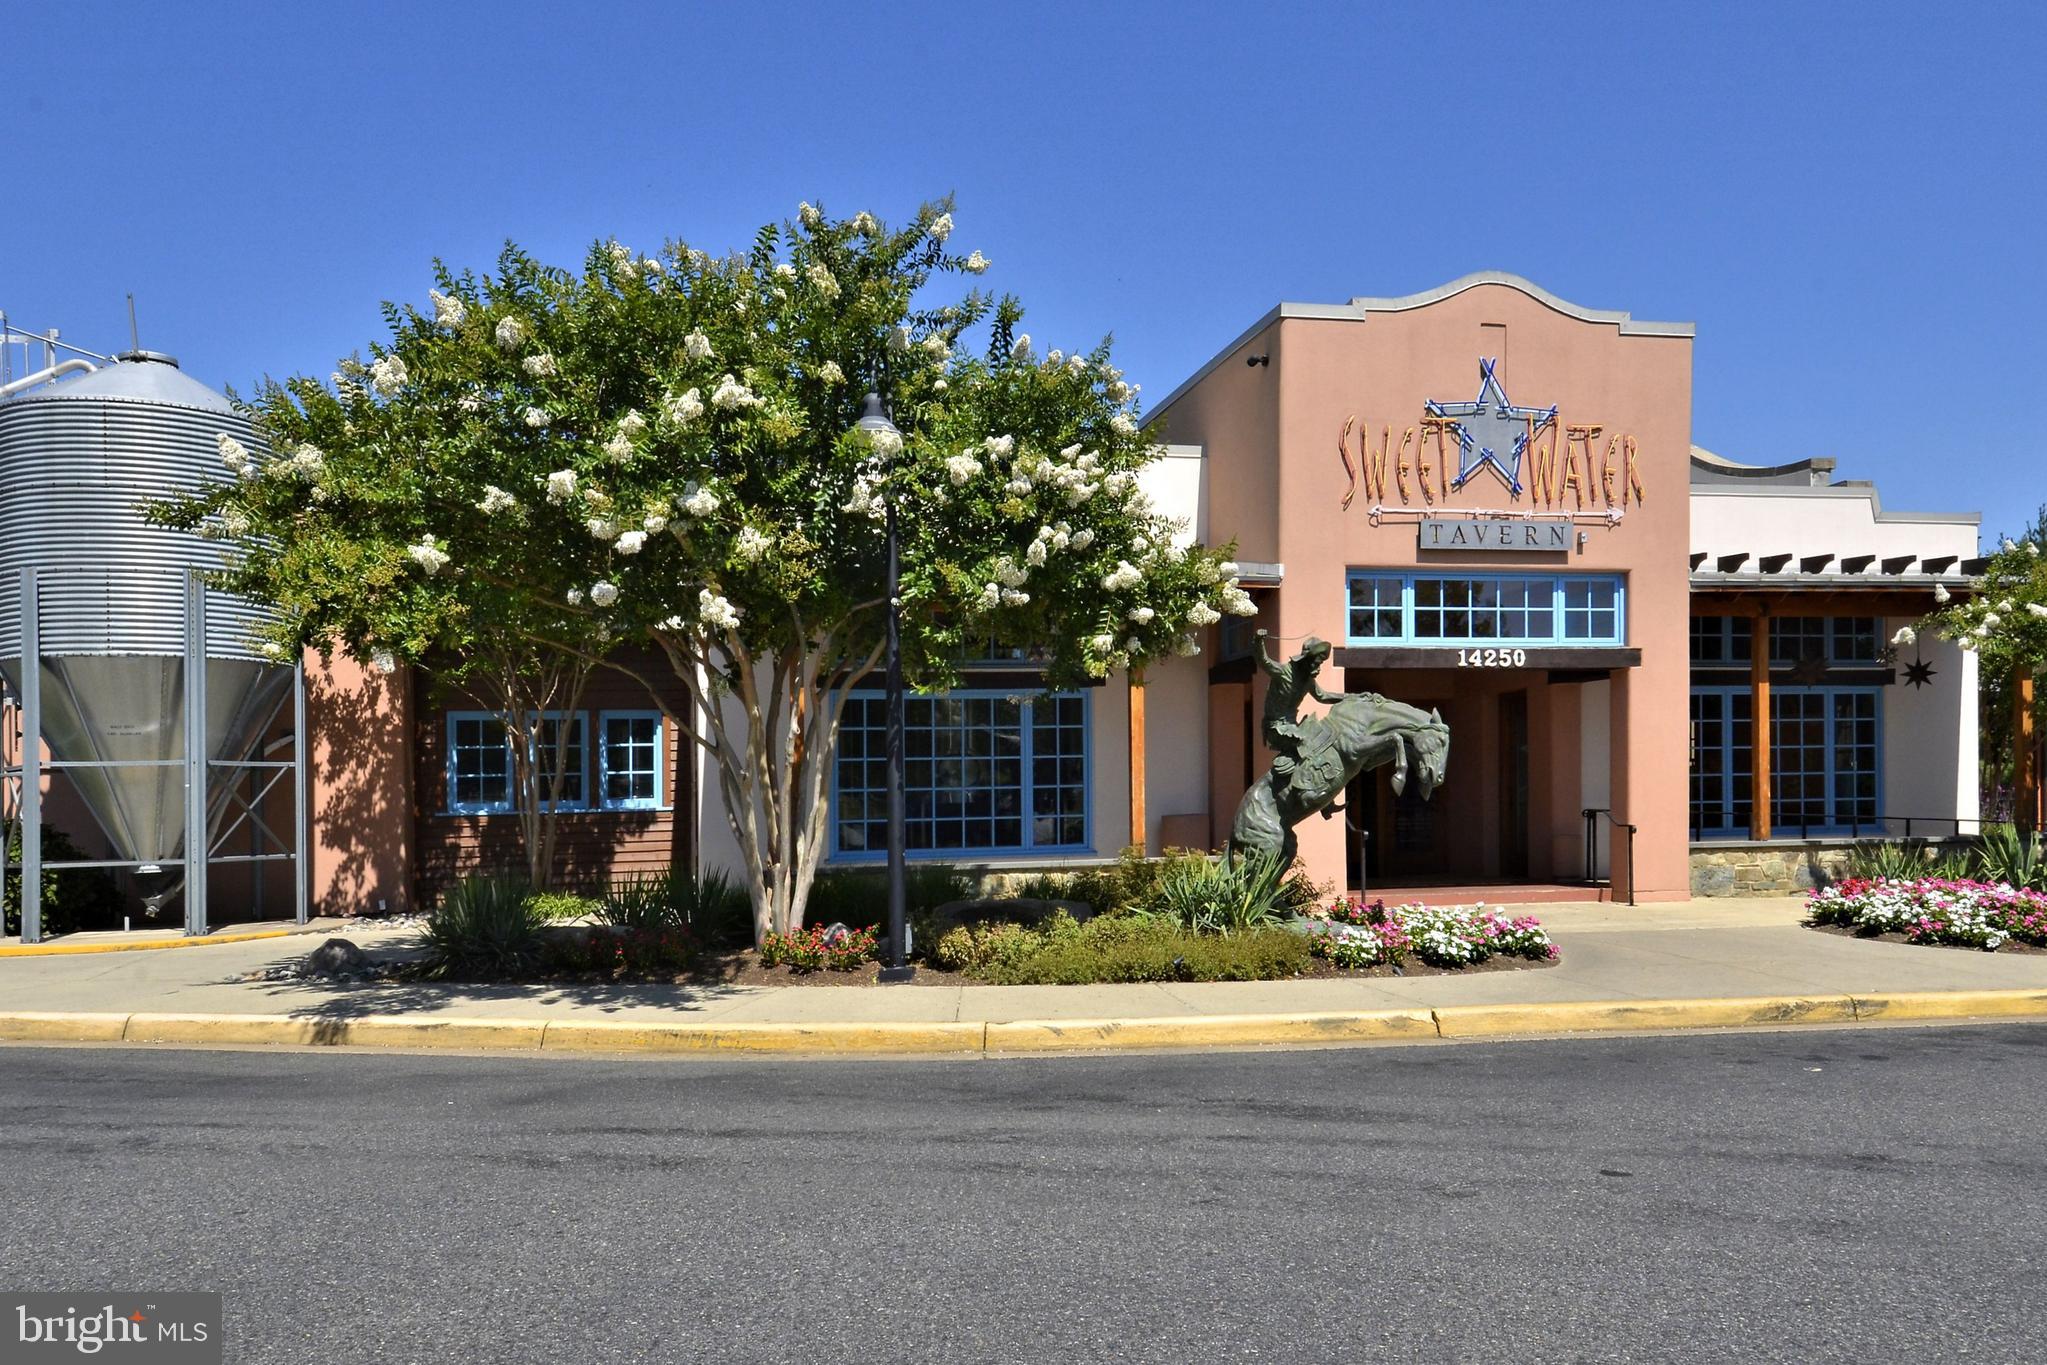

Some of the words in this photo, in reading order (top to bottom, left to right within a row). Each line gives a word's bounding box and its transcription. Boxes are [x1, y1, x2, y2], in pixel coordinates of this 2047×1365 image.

[1338, 414, 1456, 511] SWEET
[1525, 413, 1645, 510] WATER
[1429, 524, 1566, 546] TAVERN
[1457, 649, 1527, 668] 14250
